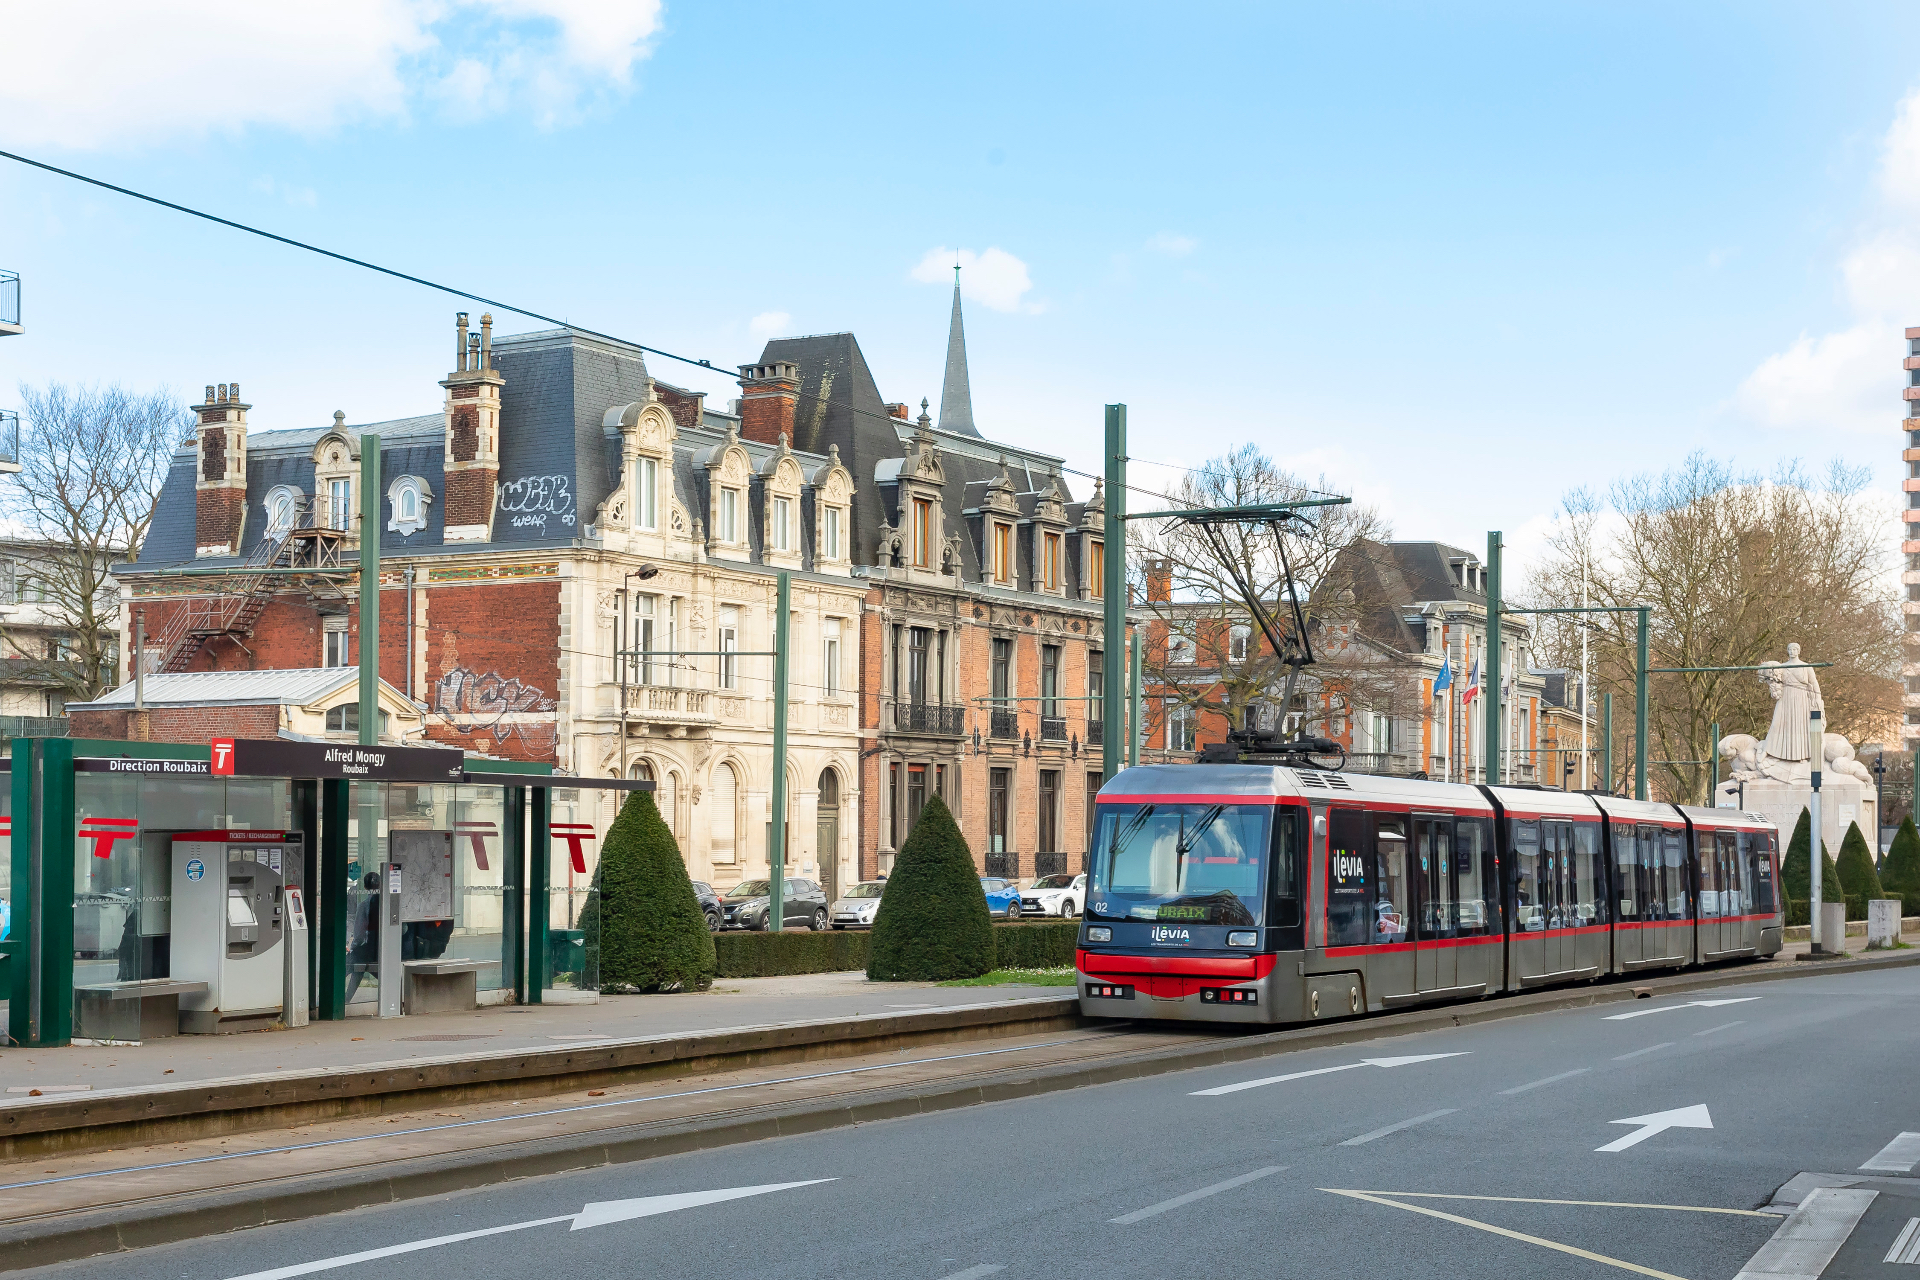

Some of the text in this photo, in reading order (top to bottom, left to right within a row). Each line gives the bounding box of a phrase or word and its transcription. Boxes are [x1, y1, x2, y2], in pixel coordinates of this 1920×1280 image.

[325, 749, 385, 766] Alfred Mongy
[110, 761, 208, 773] Direction Roubaix
[342, 764, 369, 774] Roubaix
[1095, 902, 1108, 912] 02
